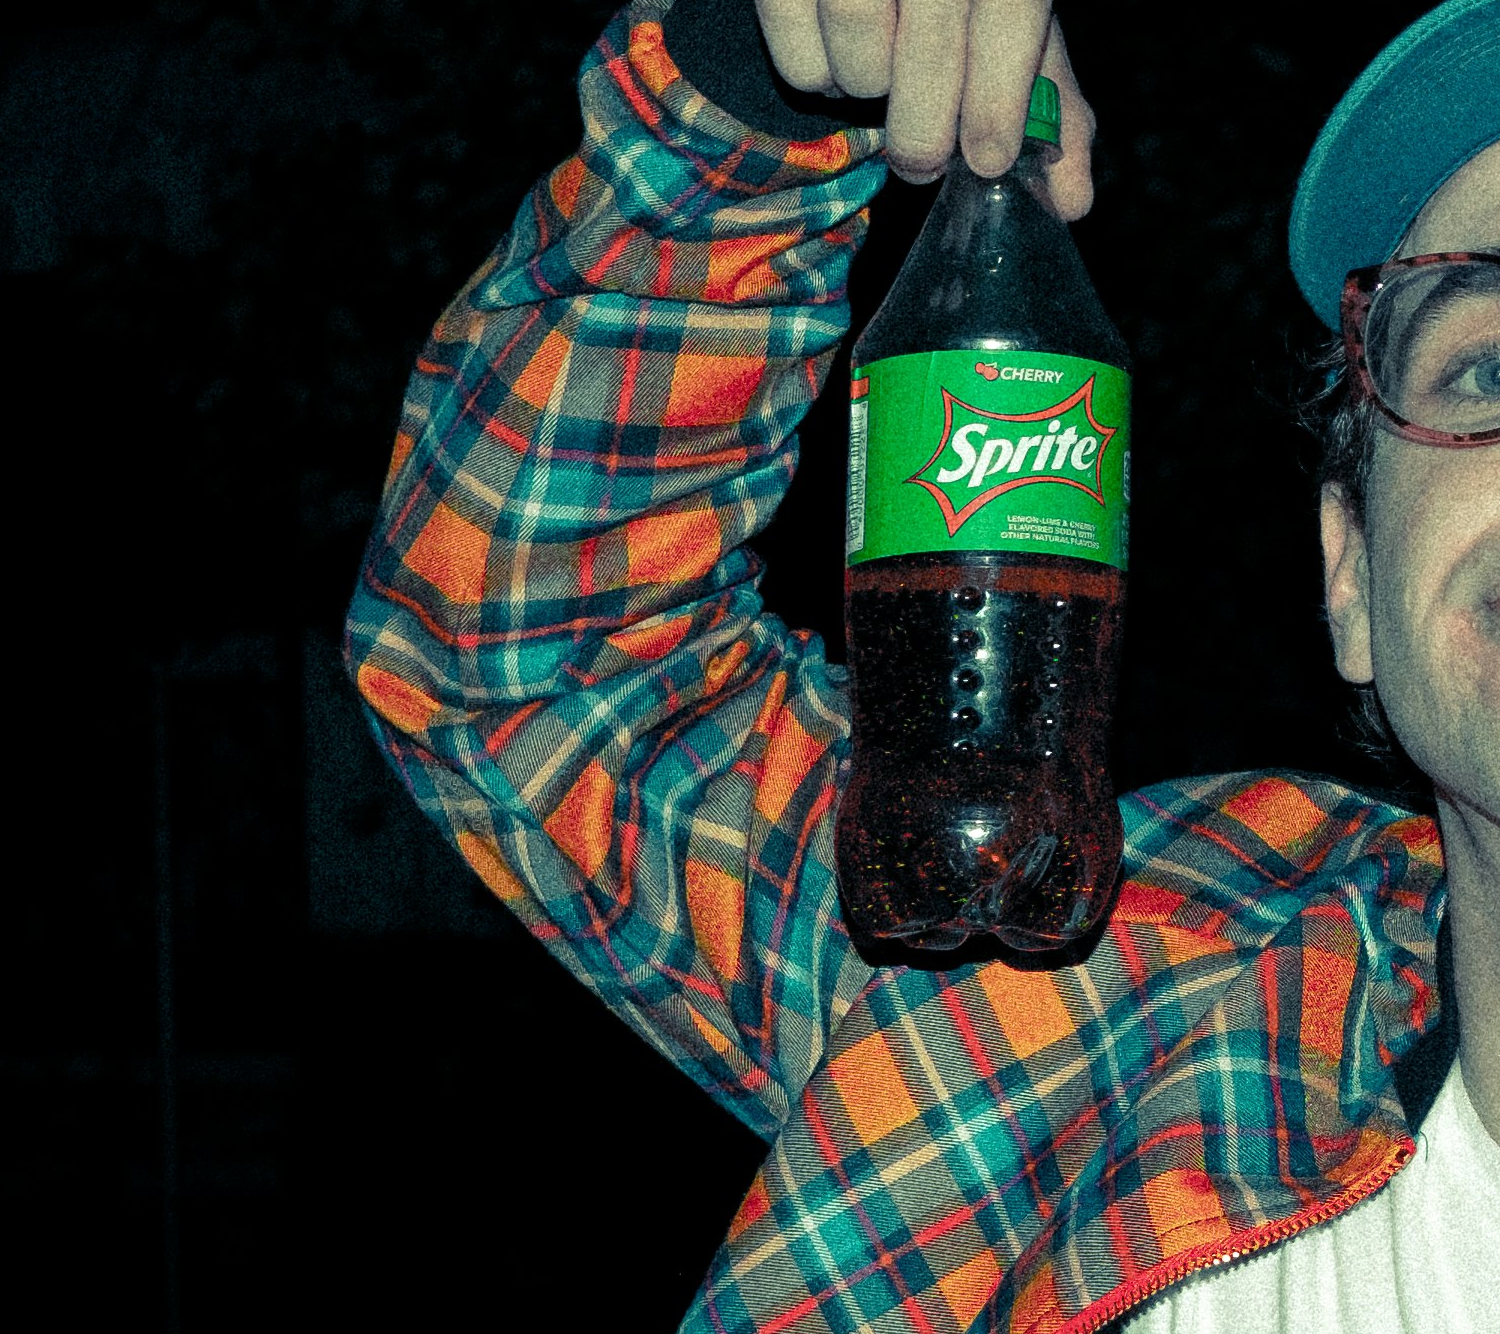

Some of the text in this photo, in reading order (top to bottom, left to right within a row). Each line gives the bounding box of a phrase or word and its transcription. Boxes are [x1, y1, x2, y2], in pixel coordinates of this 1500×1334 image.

[1000, 367, 1064, 383] CHERRY
[936, 420, 1097, 488] Sprite
[1008, 524, 1053, 533] FLAVORED
[1054, 527, 1077, 537] SODA
[1069, 521, 1096, 531] CHERRY
[1000, 531, 1100, 549] OTHER NATURAL FLAVORS
